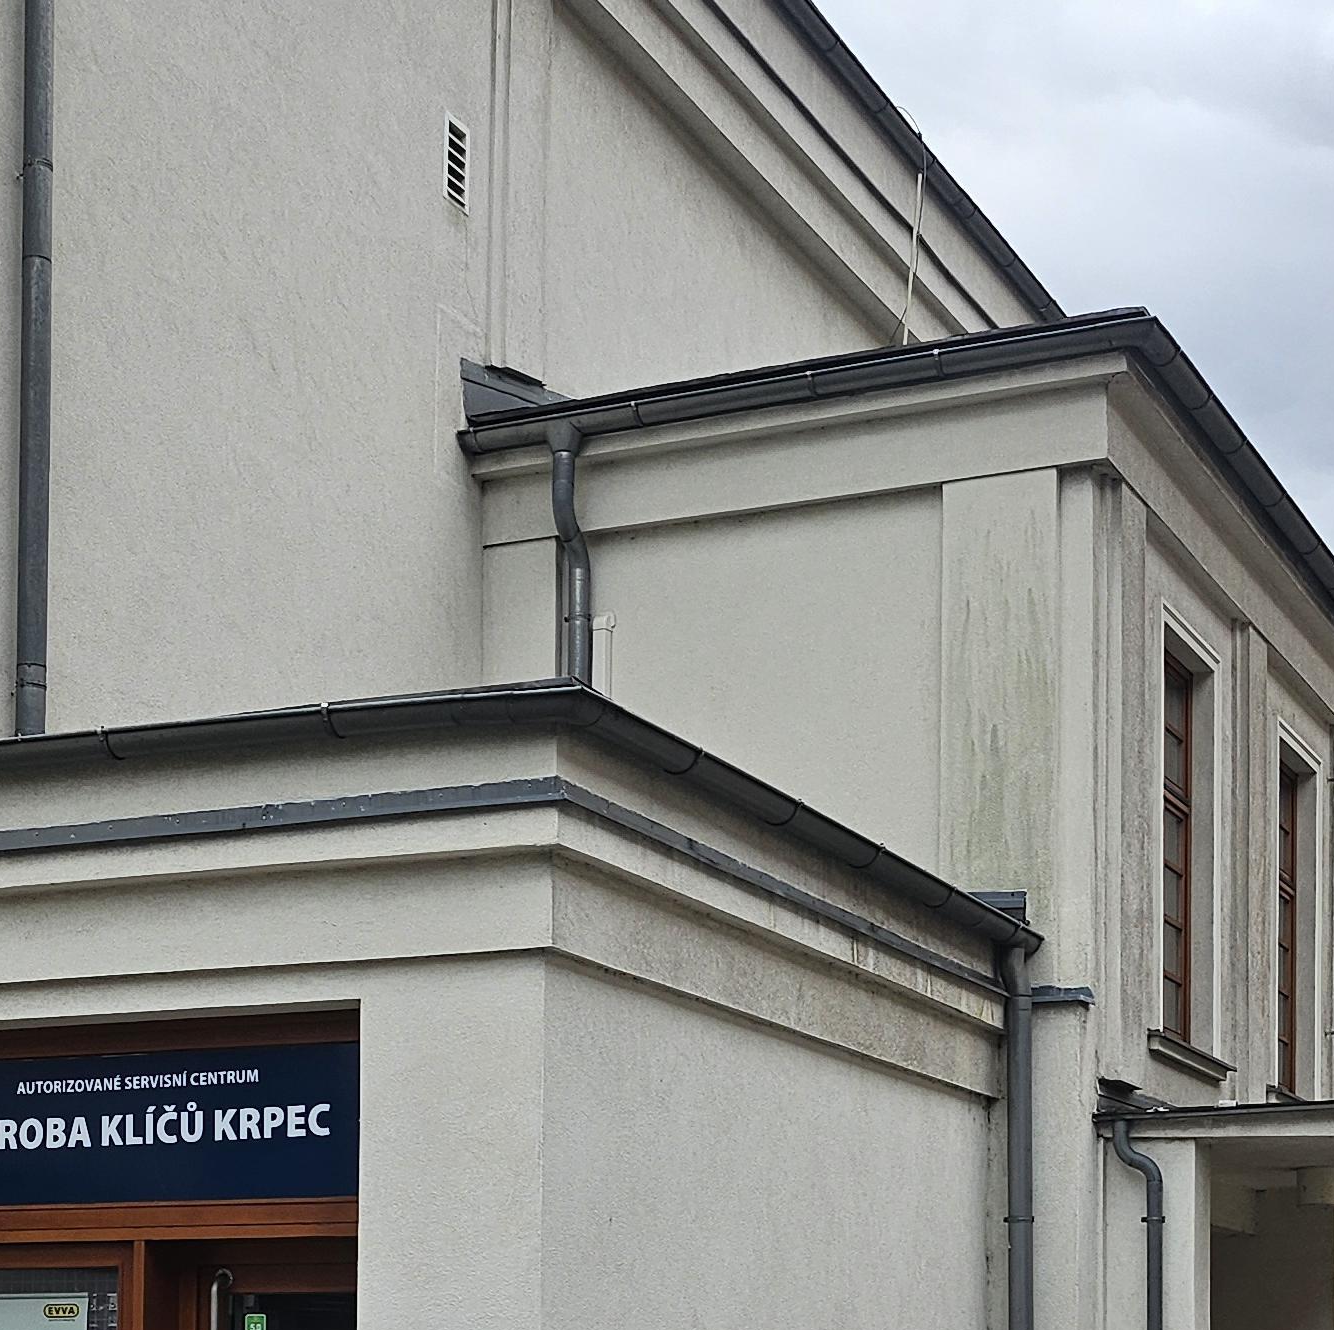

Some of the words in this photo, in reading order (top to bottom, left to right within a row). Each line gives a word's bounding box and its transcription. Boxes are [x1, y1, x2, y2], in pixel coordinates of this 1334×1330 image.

[16, 1075, 122, 1095] AUTORIZOVANÉ
[124, 1070, 188, 1089] SERVISNÍ
[190, 1069, 259, 1087] CENTRUM
[101, 1101, 204, 1146] KLÍČŮ
[214, 1103, 330, 1142] KRPEC
[47, 1306, 76, 1315] EVVA
